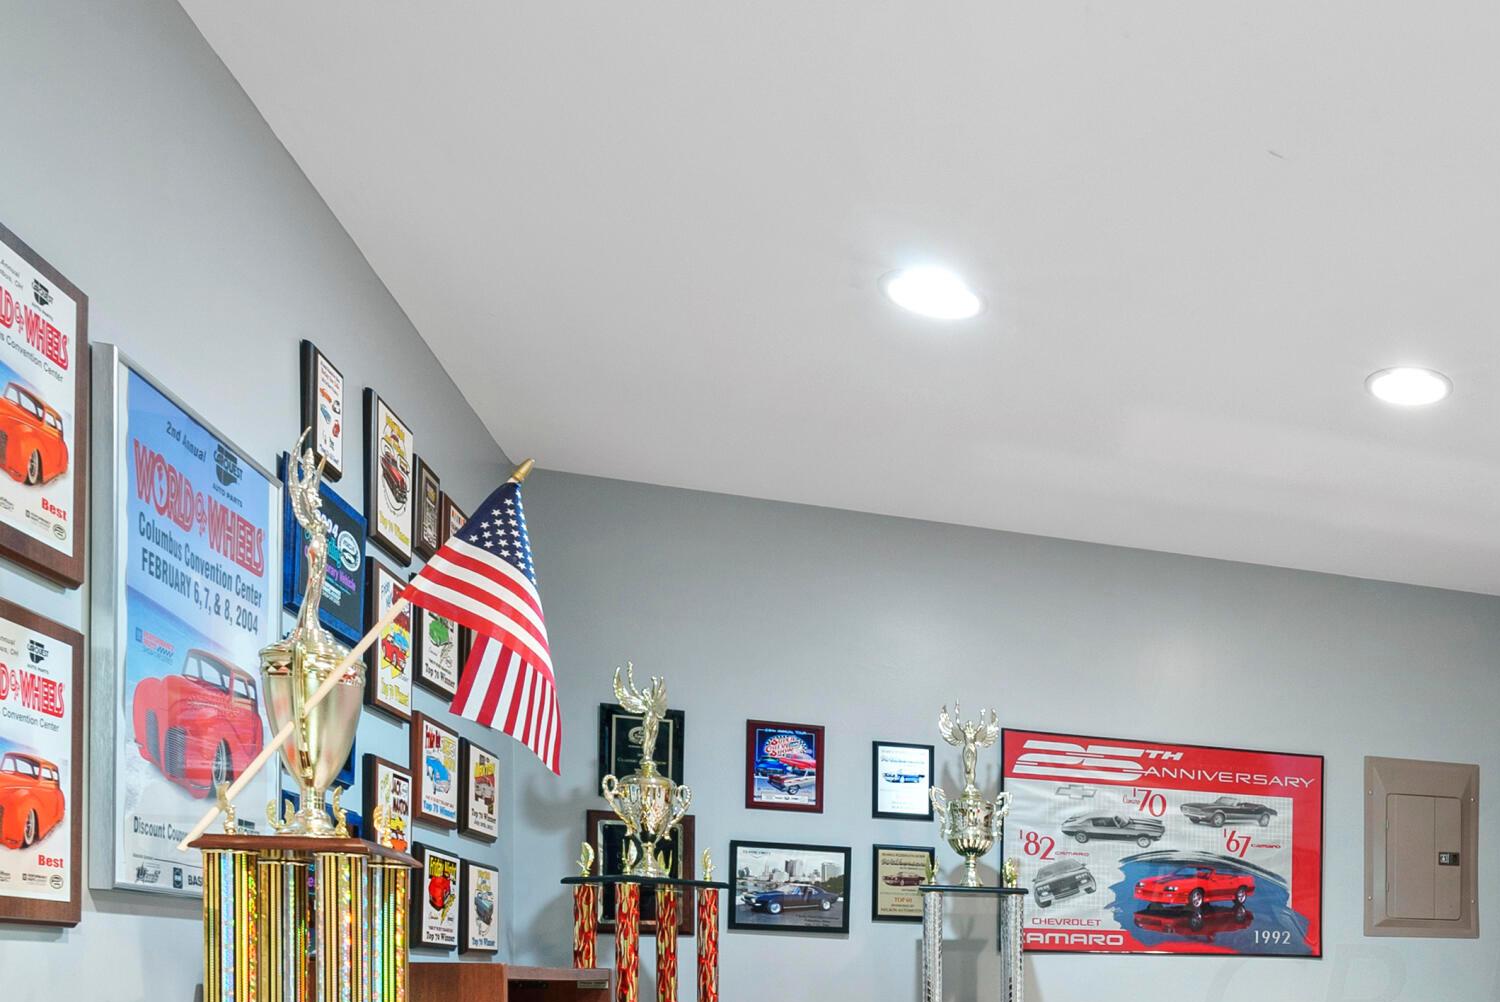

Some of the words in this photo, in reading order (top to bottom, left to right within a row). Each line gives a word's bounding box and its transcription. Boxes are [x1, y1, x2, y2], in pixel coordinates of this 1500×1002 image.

[24, 304, 69, 371] WHEELS
[165, 421, 181, 441] 2nd
[182, 434, 207, 463] Annual
[41, 497, 67, 521] Best
[133, 437, 195, 534] WORLD
[207, 493, 266, 579] WHEELS
[138, 511, 182, 562] Columbus
[184, 544, 233, 594] Convention
[234, 573, 262, 608] Center
[141, 547, 192, 600] FEBRUARY
[213, 593, 221, 616] &
[236, 605, 259, 637] 2004
[20, 669, 65, 718] WHEELS
[1140, 765, 1316, 789] ANNIVERSARY
[133, 816, 165, 840] Discount
[38, 853, 64, 869] Best
[1032, 917, 1102, 927] CHEVROLET
[1024, 932, 1124, 946] AMARO
[1253, 930, 1291, 945] 1992
